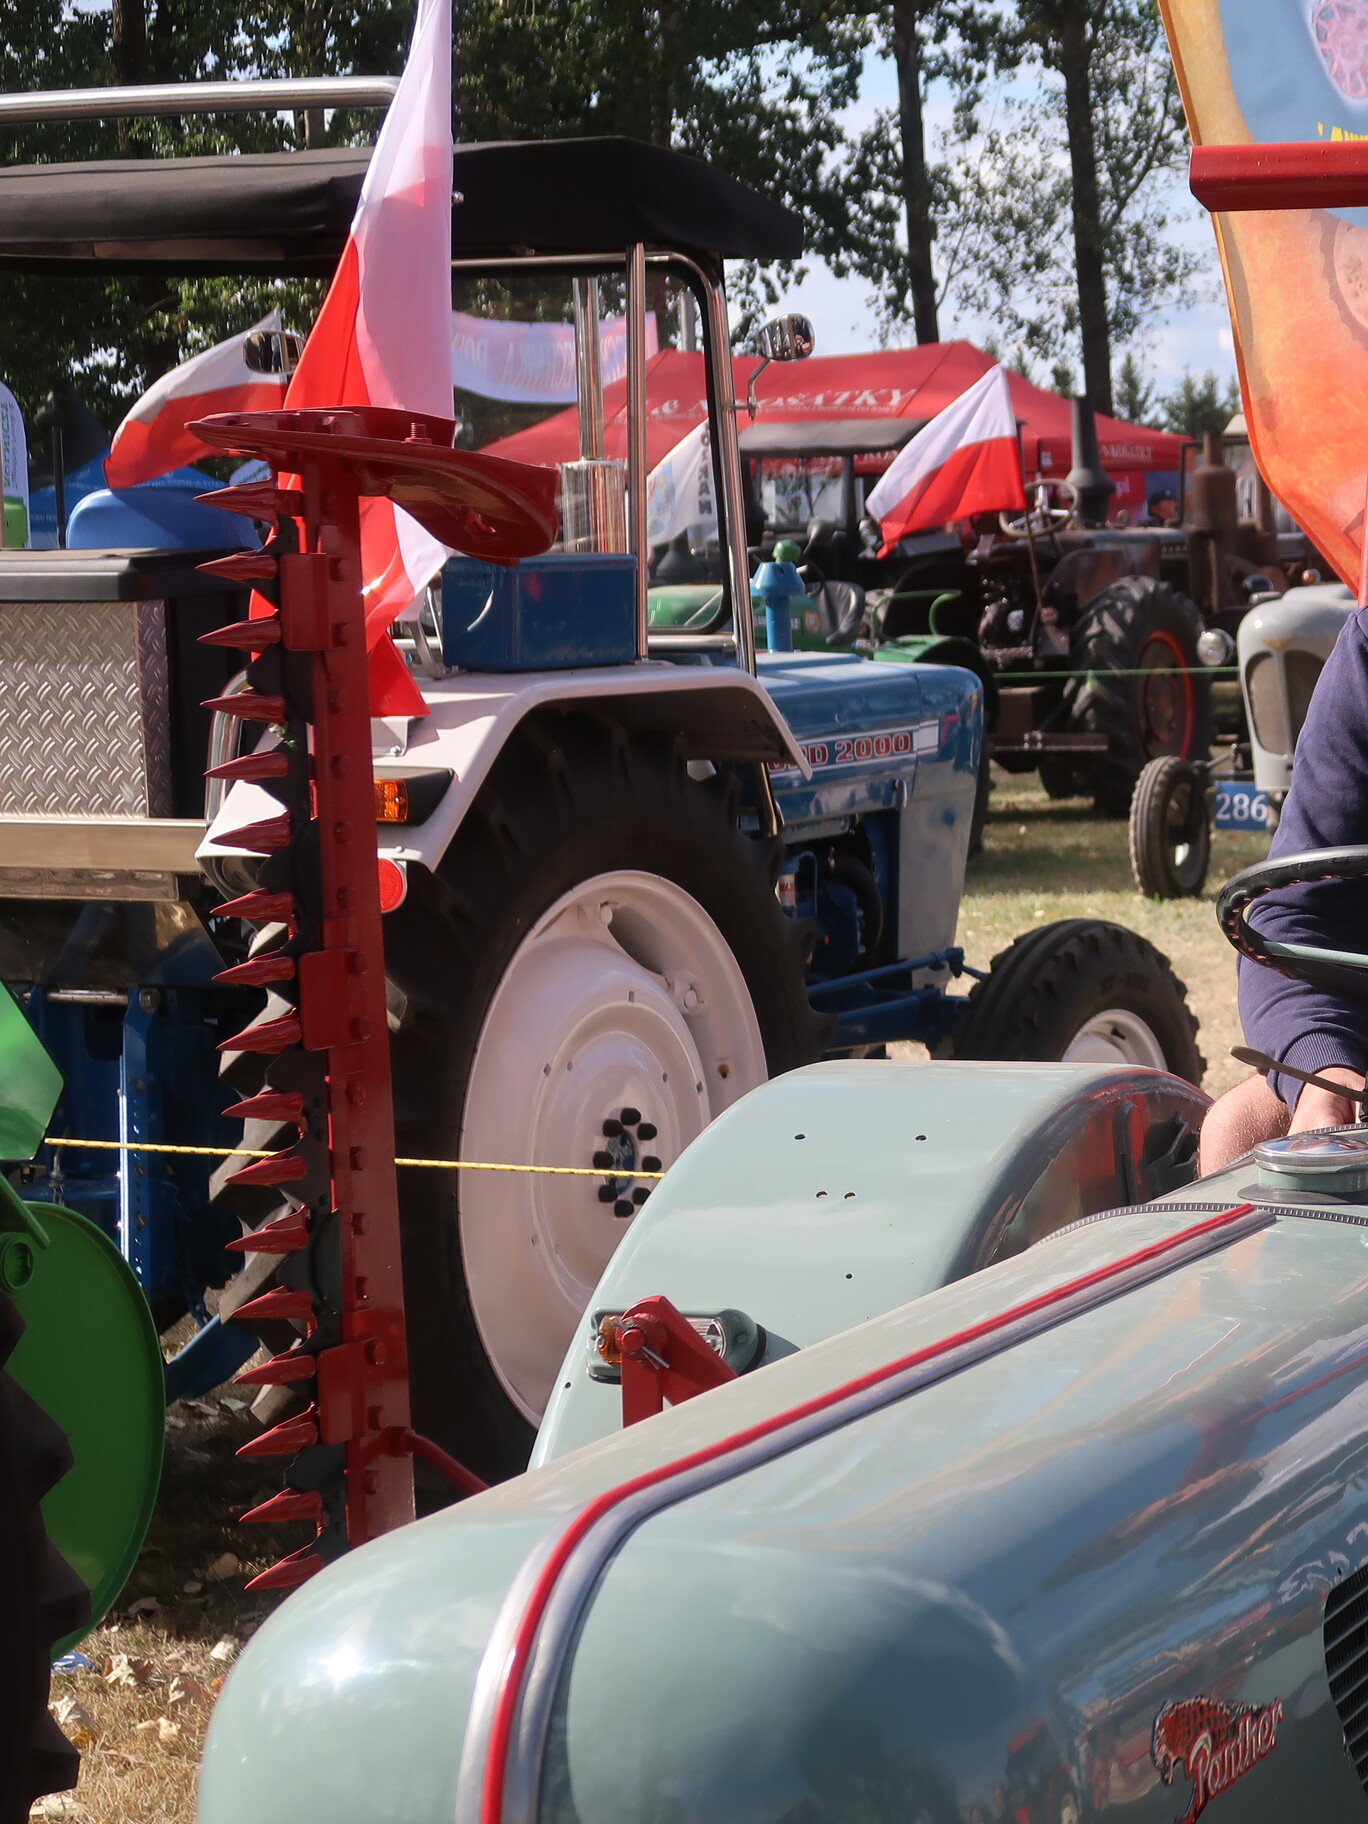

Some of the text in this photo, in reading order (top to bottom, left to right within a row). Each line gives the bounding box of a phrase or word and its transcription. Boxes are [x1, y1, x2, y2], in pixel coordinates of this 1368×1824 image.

[836, 731, 911, 763] 2000
[1215, 792, 1268, 823] 286
[1187, 1698, 1284, 1806] Panther
